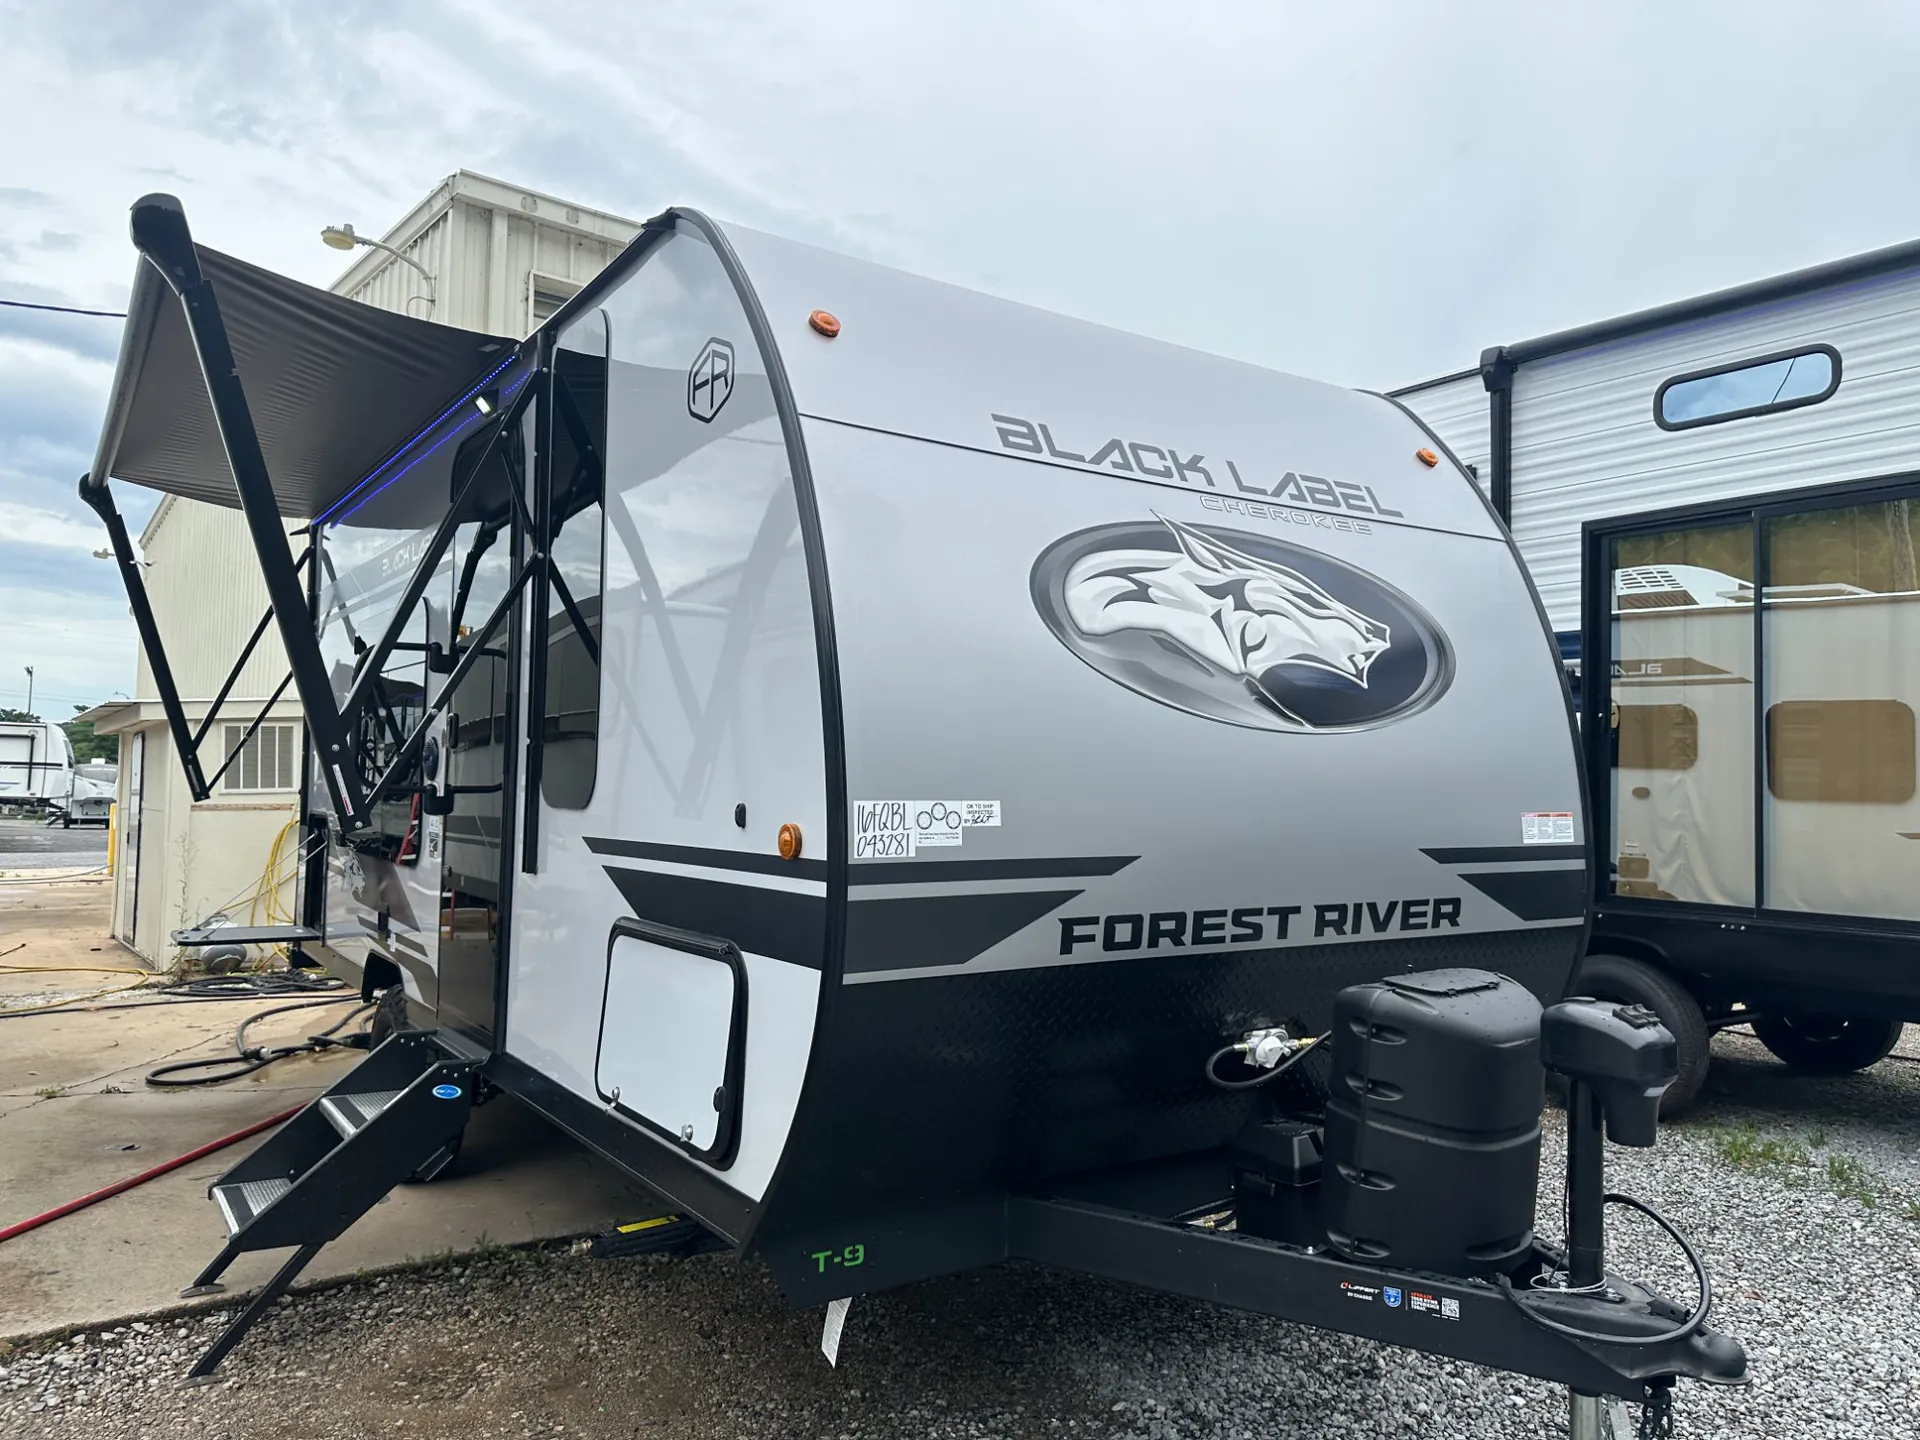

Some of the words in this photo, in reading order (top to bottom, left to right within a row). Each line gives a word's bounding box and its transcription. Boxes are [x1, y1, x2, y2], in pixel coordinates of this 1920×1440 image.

[991, 413, 1216, 487] BLACK
[1225, 460, 1404, 518] LABEL
[1200, 495, 1372, 535] CHEROKEE
[857, 833, 909, 858] 043281
[1058, 906, 1302, 955] FOREST
[1313, 897, 1462, 938] RIVER
[812, 1244, 865, 1273] T-9
